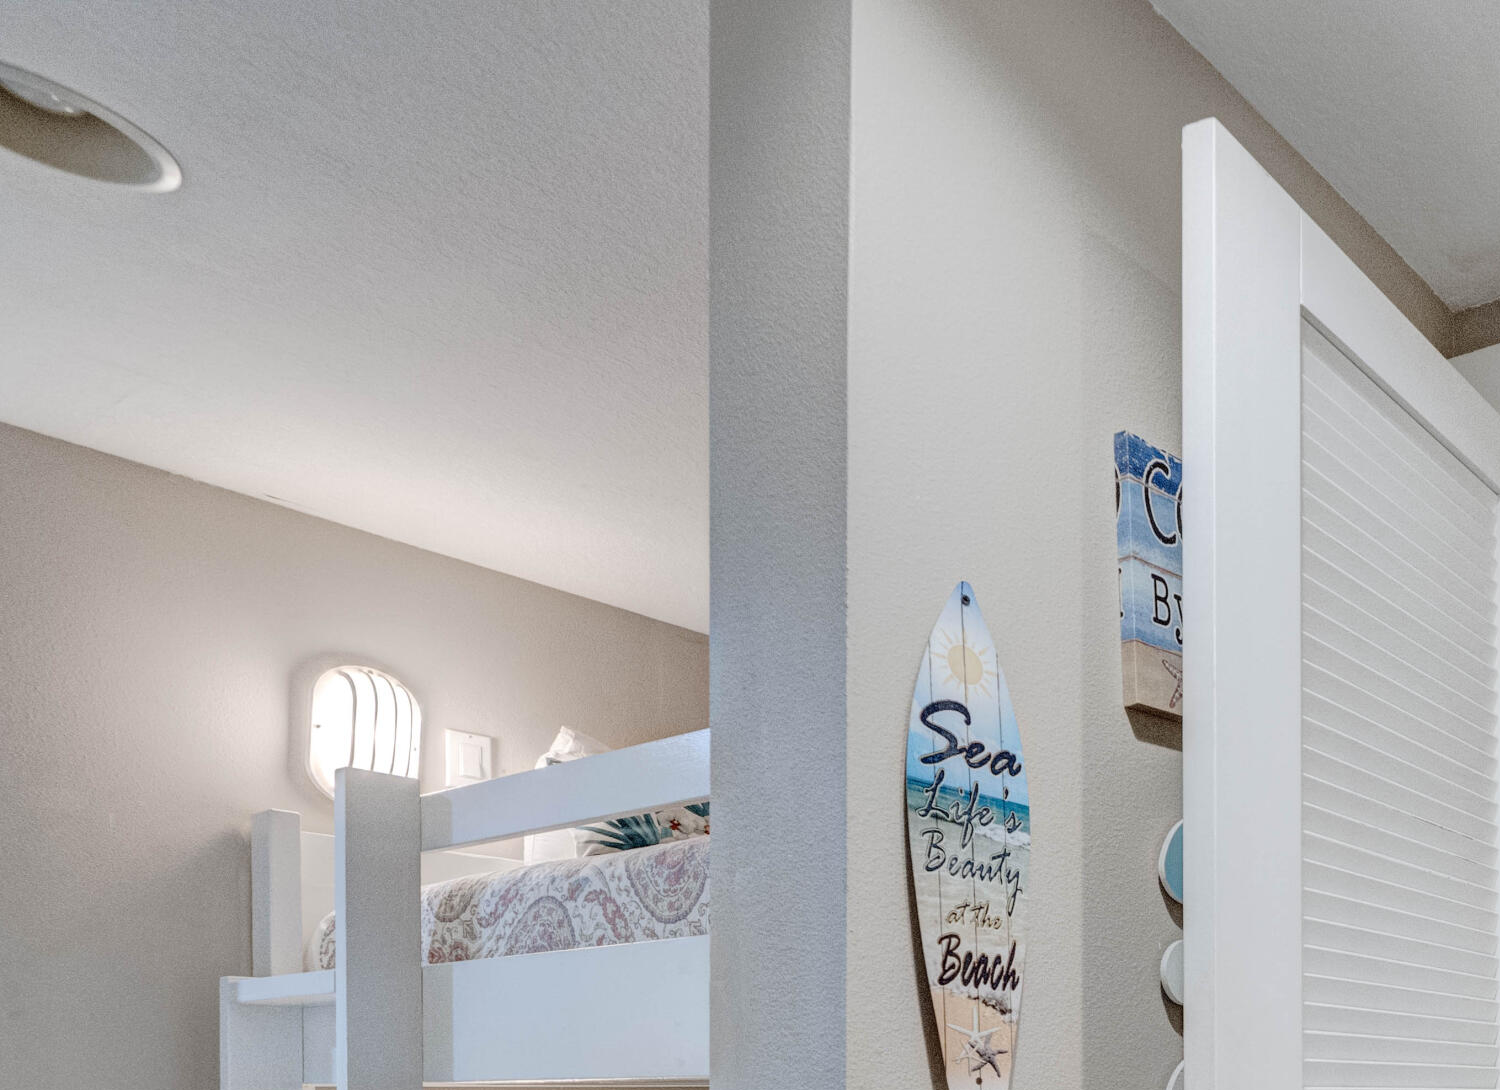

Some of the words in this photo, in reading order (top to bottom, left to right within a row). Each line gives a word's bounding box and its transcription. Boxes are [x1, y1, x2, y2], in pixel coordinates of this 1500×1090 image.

[1145, 459, 1182, 545] C
[920, 699, 1022, 776] Sea
[916, 768, 1022, 849] Life's
[921, 829, 1023, 916] Beauty
[946, 902, 970, 925] at
[970, 903, 1003, 930] the
[937, 933, 1020, 991] Beach
